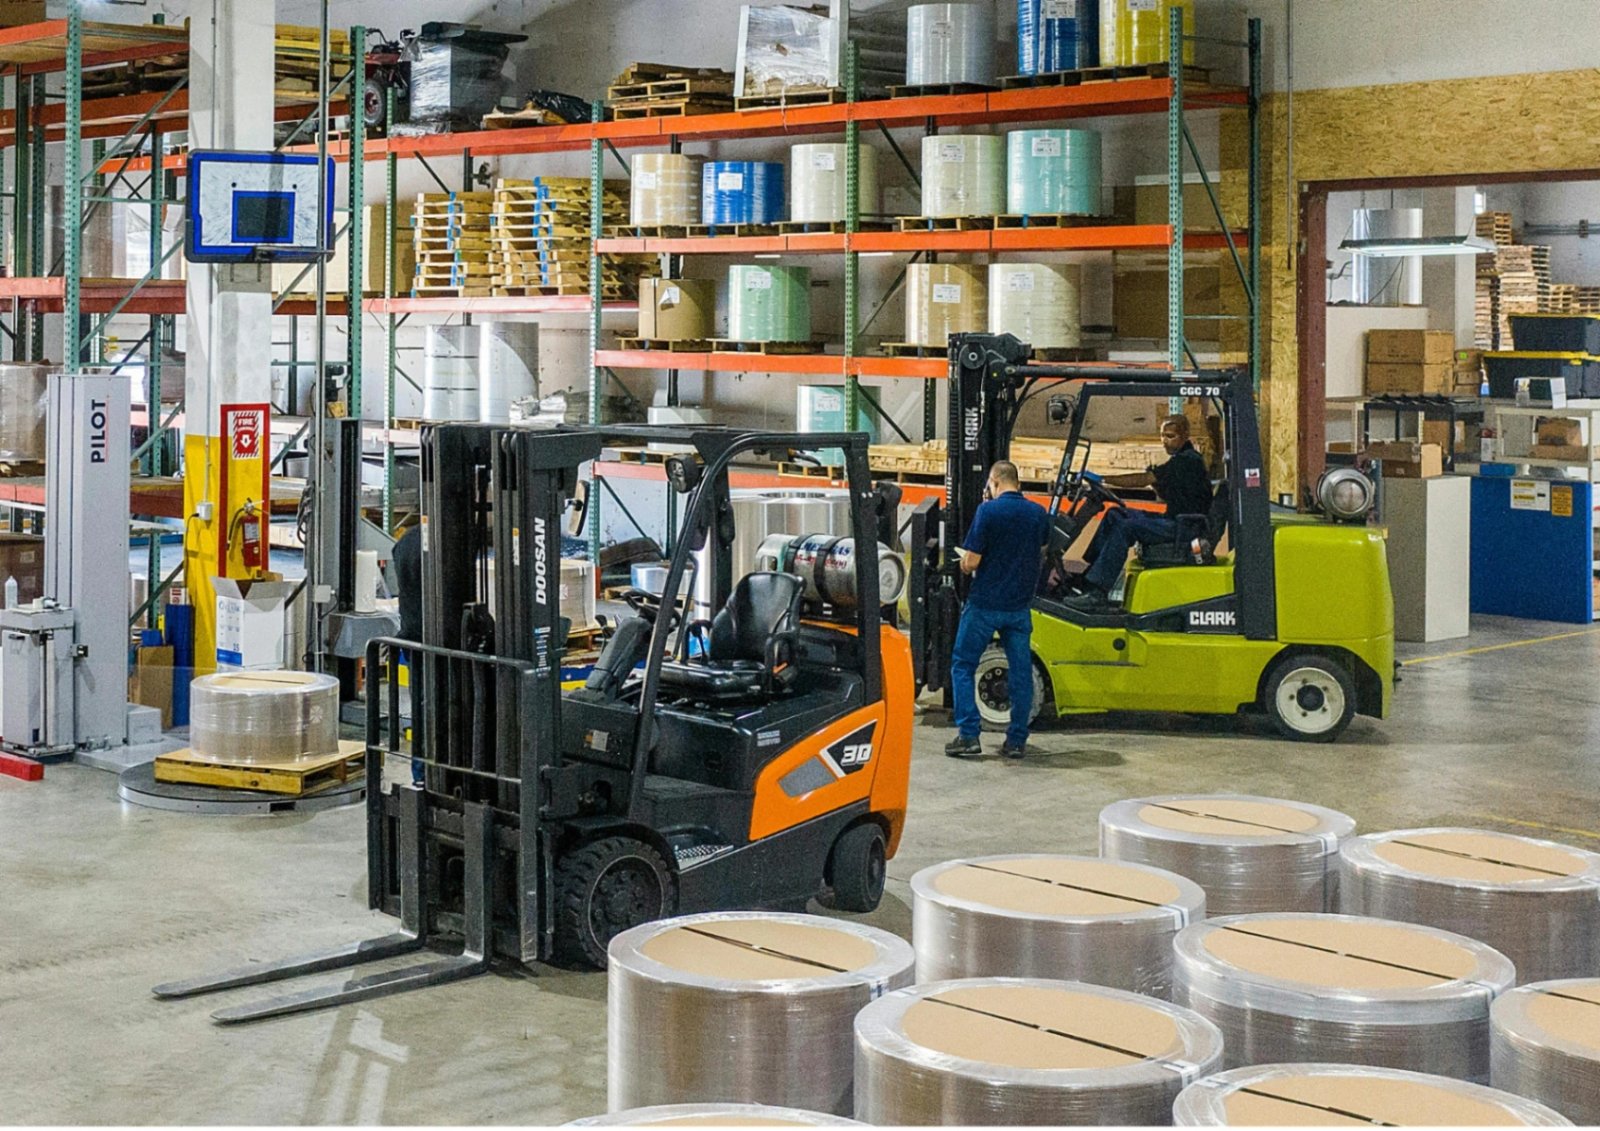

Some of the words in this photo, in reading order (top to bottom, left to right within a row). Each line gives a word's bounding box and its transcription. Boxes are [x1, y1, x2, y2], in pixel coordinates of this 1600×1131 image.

[1180, 386, 1202, 396] CGC
[1205, 386, 1220, 396] 70
[91, 399, 106, 463] PILOT
[964, 407, 979, 450] CLARK
[534, 517, 547, 605] DOOSAN
[1189, 611, 1236, 626] CLARK
[841, 743, 873, 766] 30
